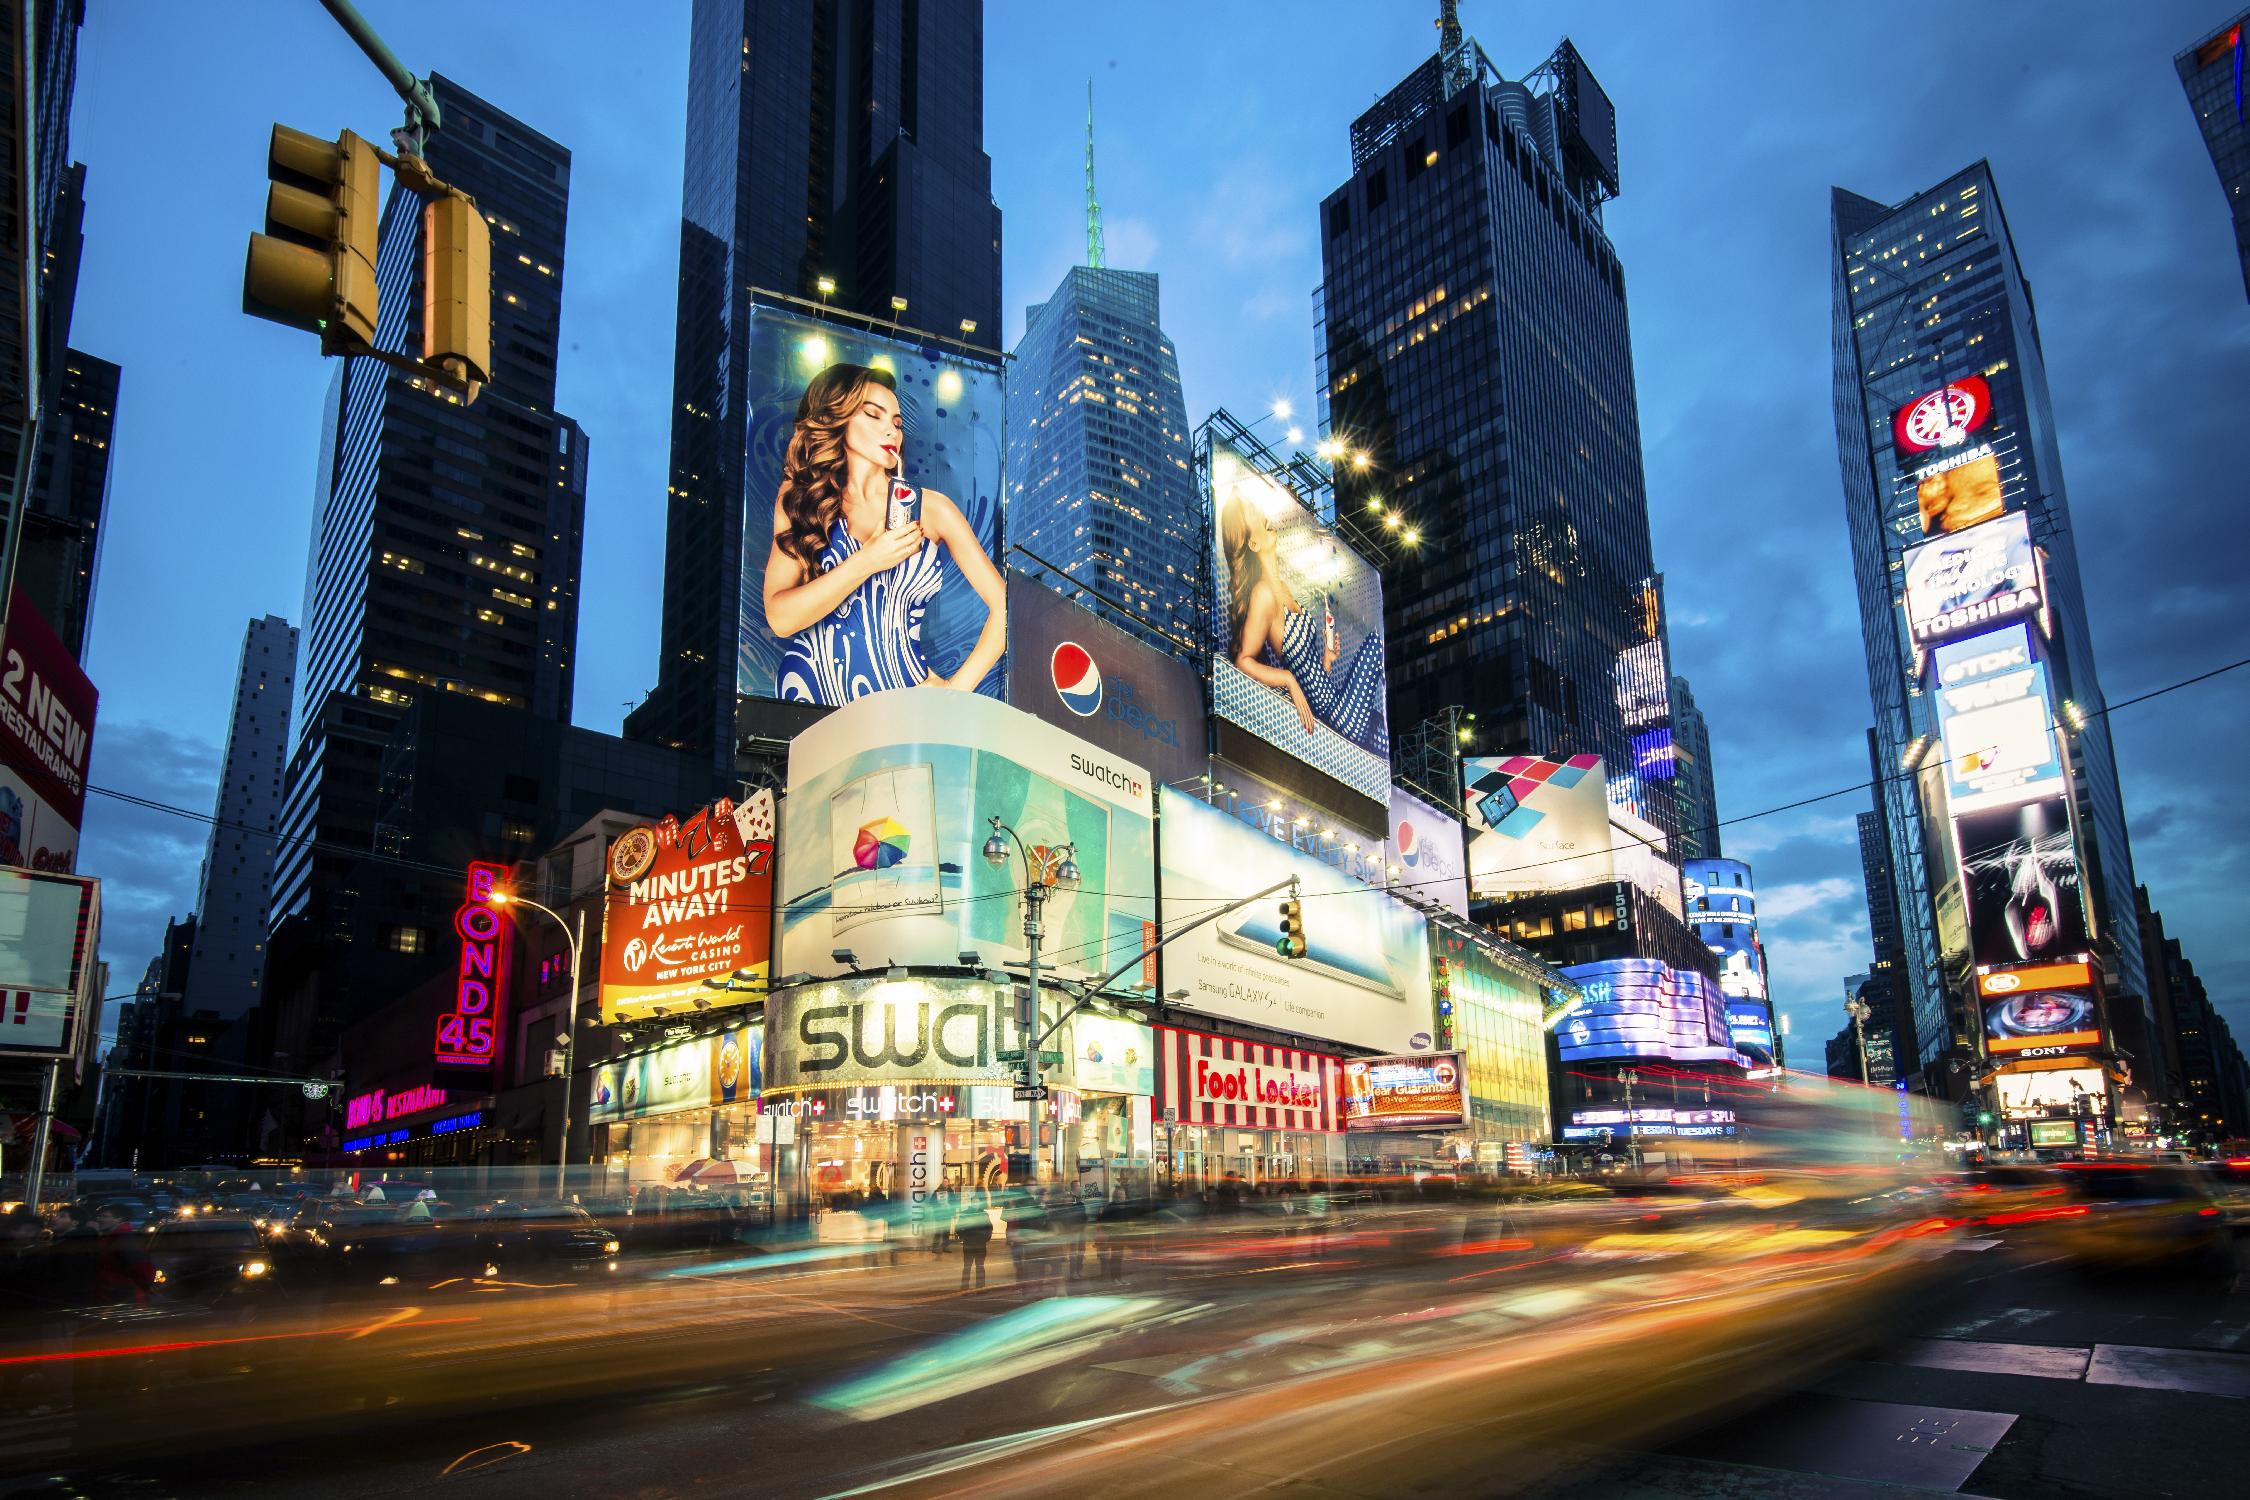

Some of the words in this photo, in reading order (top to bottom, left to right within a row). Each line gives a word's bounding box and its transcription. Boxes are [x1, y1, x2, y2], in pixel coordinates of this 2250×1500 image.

[1914, 443, 1995, 480] TOSHIBA
[1913, 588, 2039, 638] TOSHIBA
[1960, 646, 2026, 676] TDK
[2, 648, 25, 705] 2
[27, 672, 87, 769] NEW
[1106, 696, 1180, 748] pepsi
[0, 696, 80, 797] RESTAURANTS
[1071, 753, 1132, 794] swatch
[1422, 850, 1455, 878] pepsi
[1539, 841, 1575, 850] Surface
[629, 856, 746, 906] MINUTES
[642, 887, 729, 930] AWAY!
[1615, 882, 1629, 931] 1500
[460, 868, 499, 1015] BOND
[691, 944, 741, 961] CASINO
[697, 924, 744, 948] World
[656, 967, 678, 981] NEW
[681, 963, 706, 976] YORK
[708, 959, 731, 972] CITY
[1198, 979, 1227, 999] Samsung
[1229, 983, 1263, 1006] GALAXY
[1284, 999, 1295, 1013] Life
[1295, 1003, 1325, 1020] companion
[439, 1016, 492, 1053] 45
[2021, 1046, 2068, 1057] SONY
[386, 1083, 447, 1120] RESTAURANT
[1196, 1059, 1249, 1102] Foot
[1255, 1067, 1320, 1108] Locker
[1395, 1083, 1454, 1095] Guarantee
[763, 1098, 812, 1118] swatch
[846, 1091, 938, 1116] swtch
[1676, 1126, 1723, 1136] TUESDAYS
[909, 1151, 927, 1237] swatch
